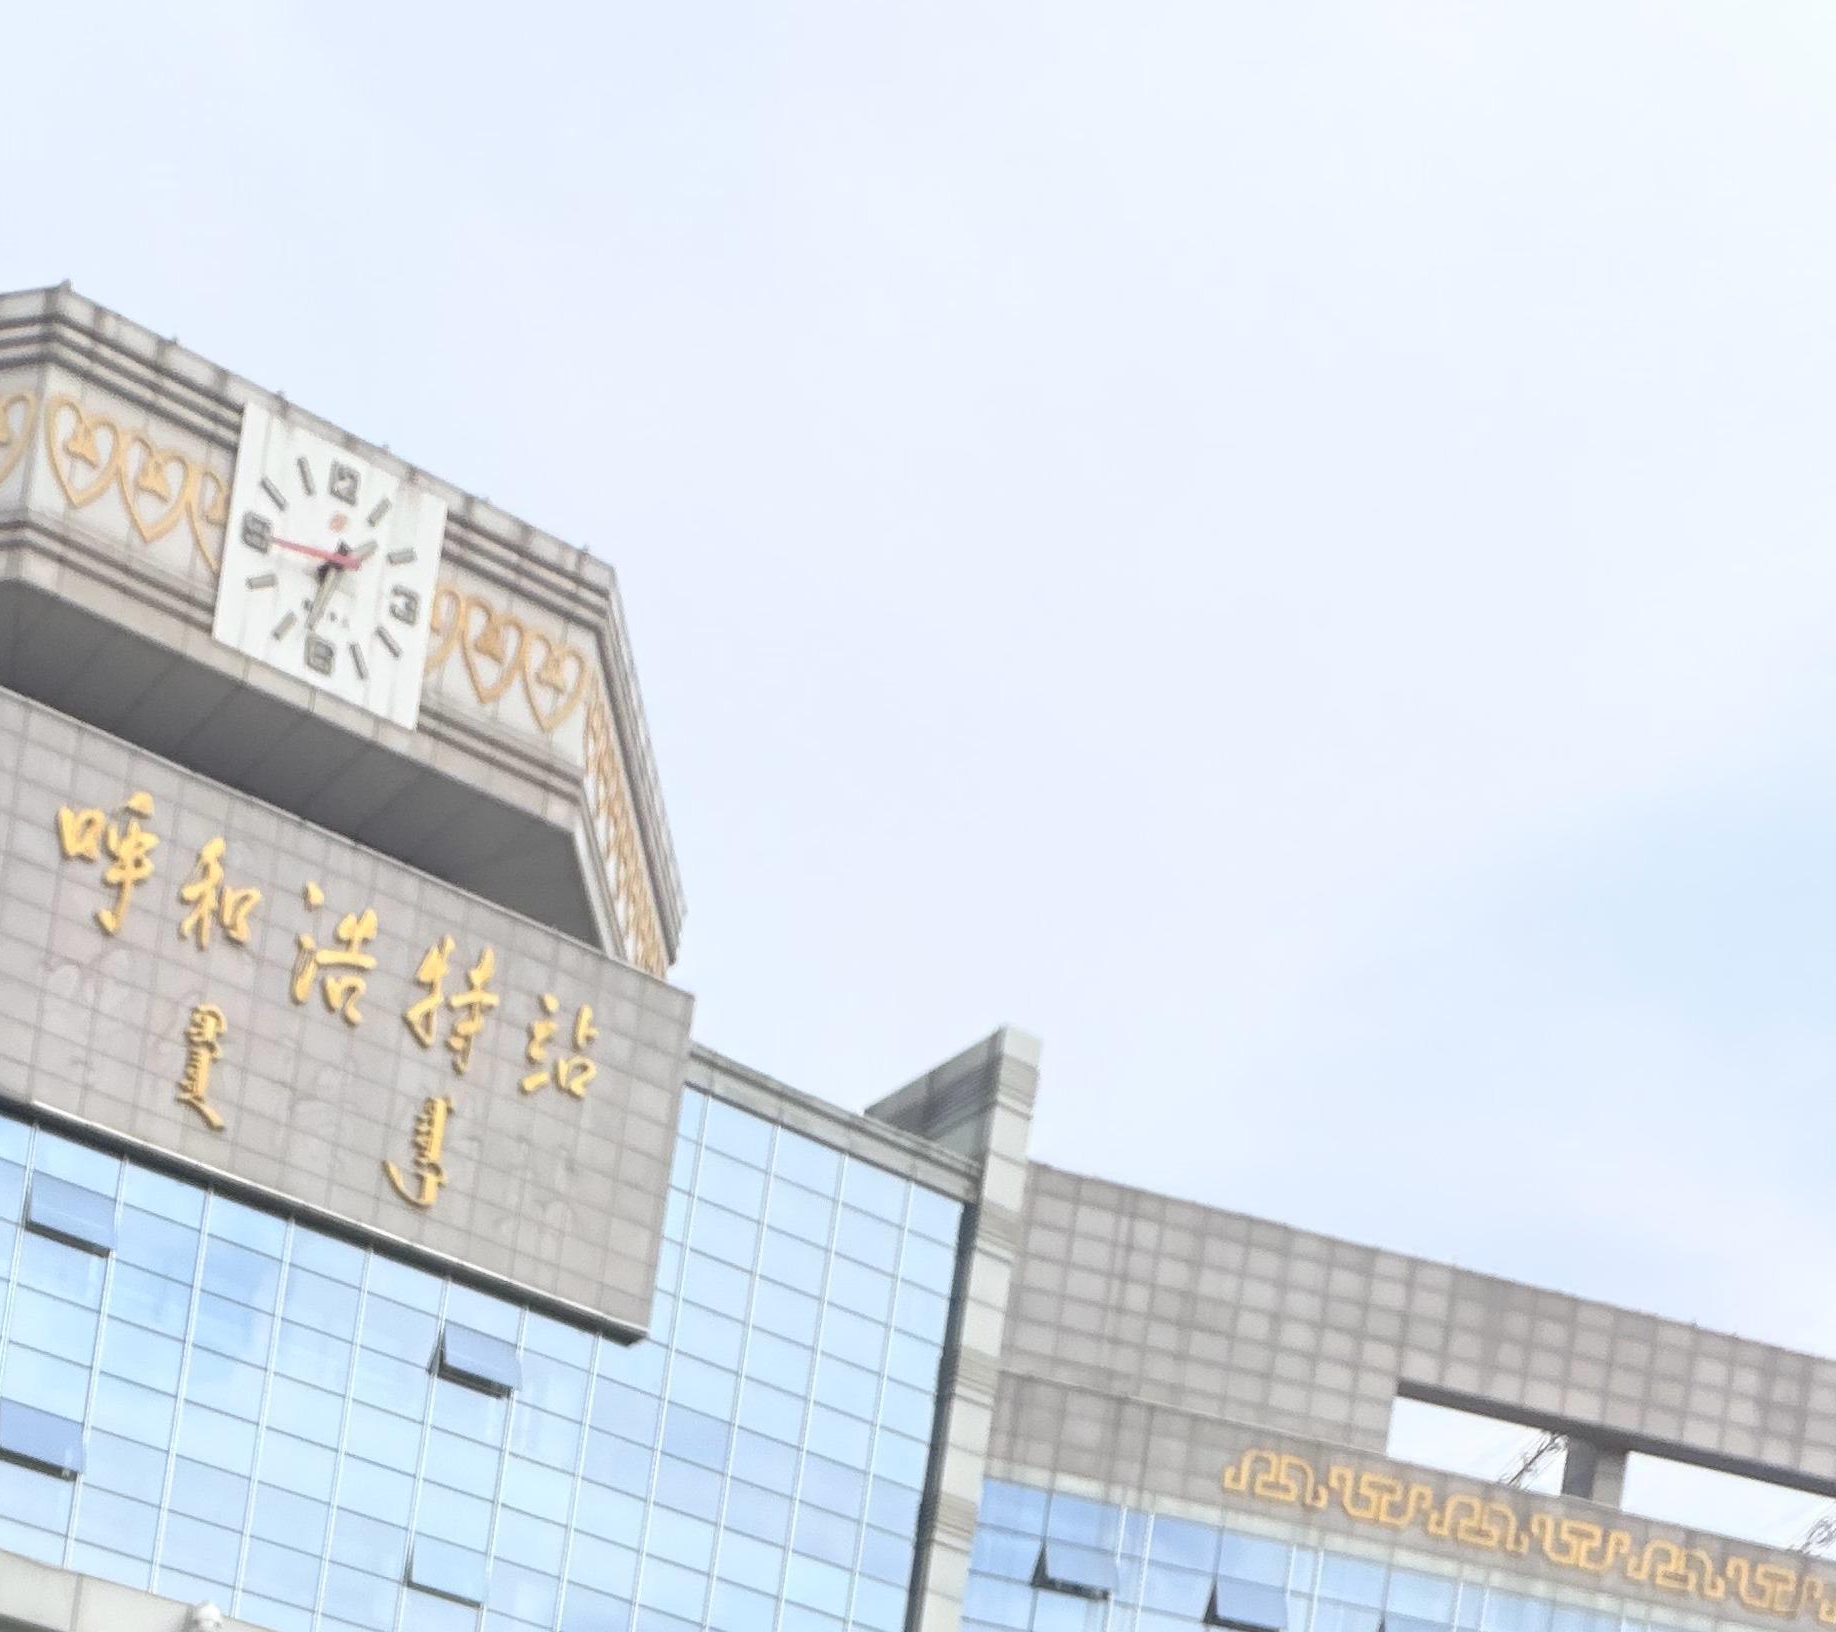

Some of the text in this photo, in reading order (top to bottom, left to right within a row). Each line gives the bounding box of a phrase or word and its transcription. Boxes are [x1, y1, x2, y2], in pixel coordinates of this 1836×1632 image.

[57, 790, 598, 1099] 呼和浩特站
